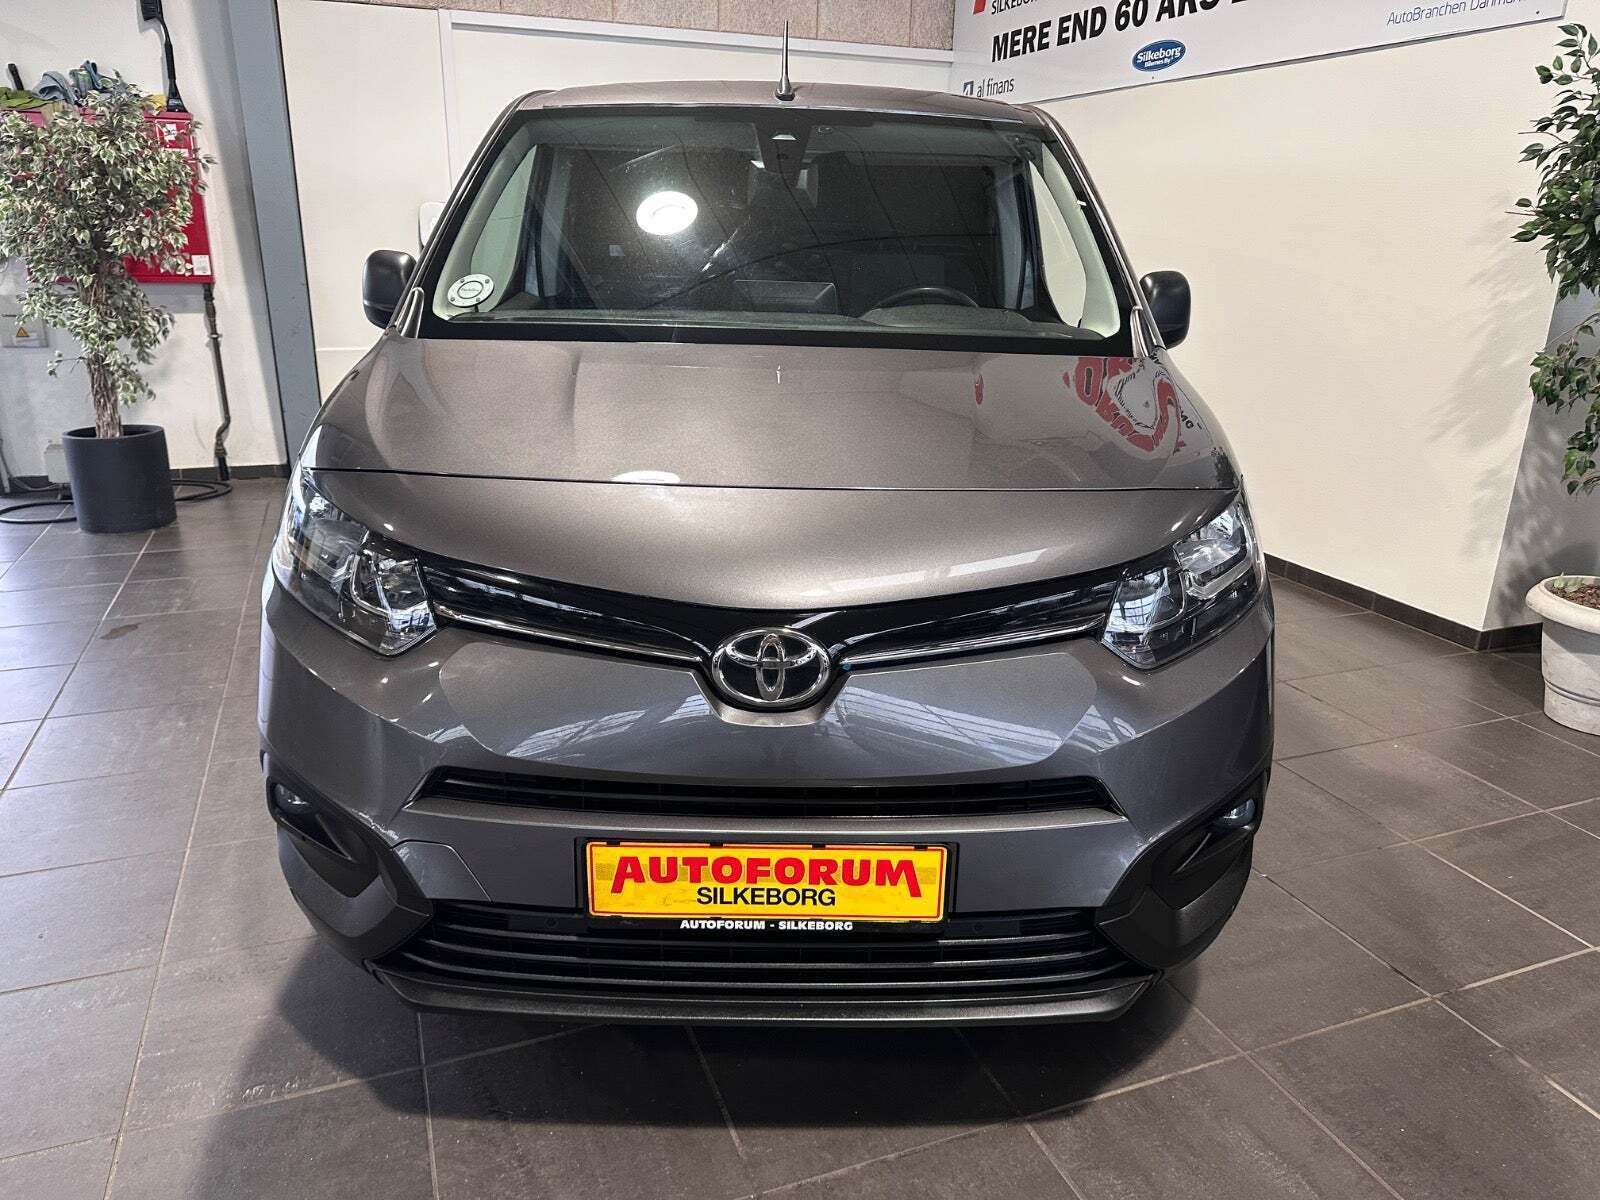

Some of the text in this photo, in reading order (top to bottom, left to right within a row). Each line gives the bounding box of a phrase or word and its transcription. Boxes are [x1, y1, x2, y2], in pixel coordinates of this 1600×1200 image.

[1387, 0, 1466, 26] AutoBranchen
[992, 20, 1052, 62] MERE
[1057, 6, 1107, 46] END
[1115, 0, 1149, 32] 60
[1137, 46, 1181, 63] Silkeborg
[977, 78, 1015, 97] al finans
[611, 856, 922, 898] AUTOFORUM
[697, 887, 836, 906] SILKEBORG
[680, 920, 766, 930] AUTOFORUM
[778, 921, 853, 931] SILKEBORG
